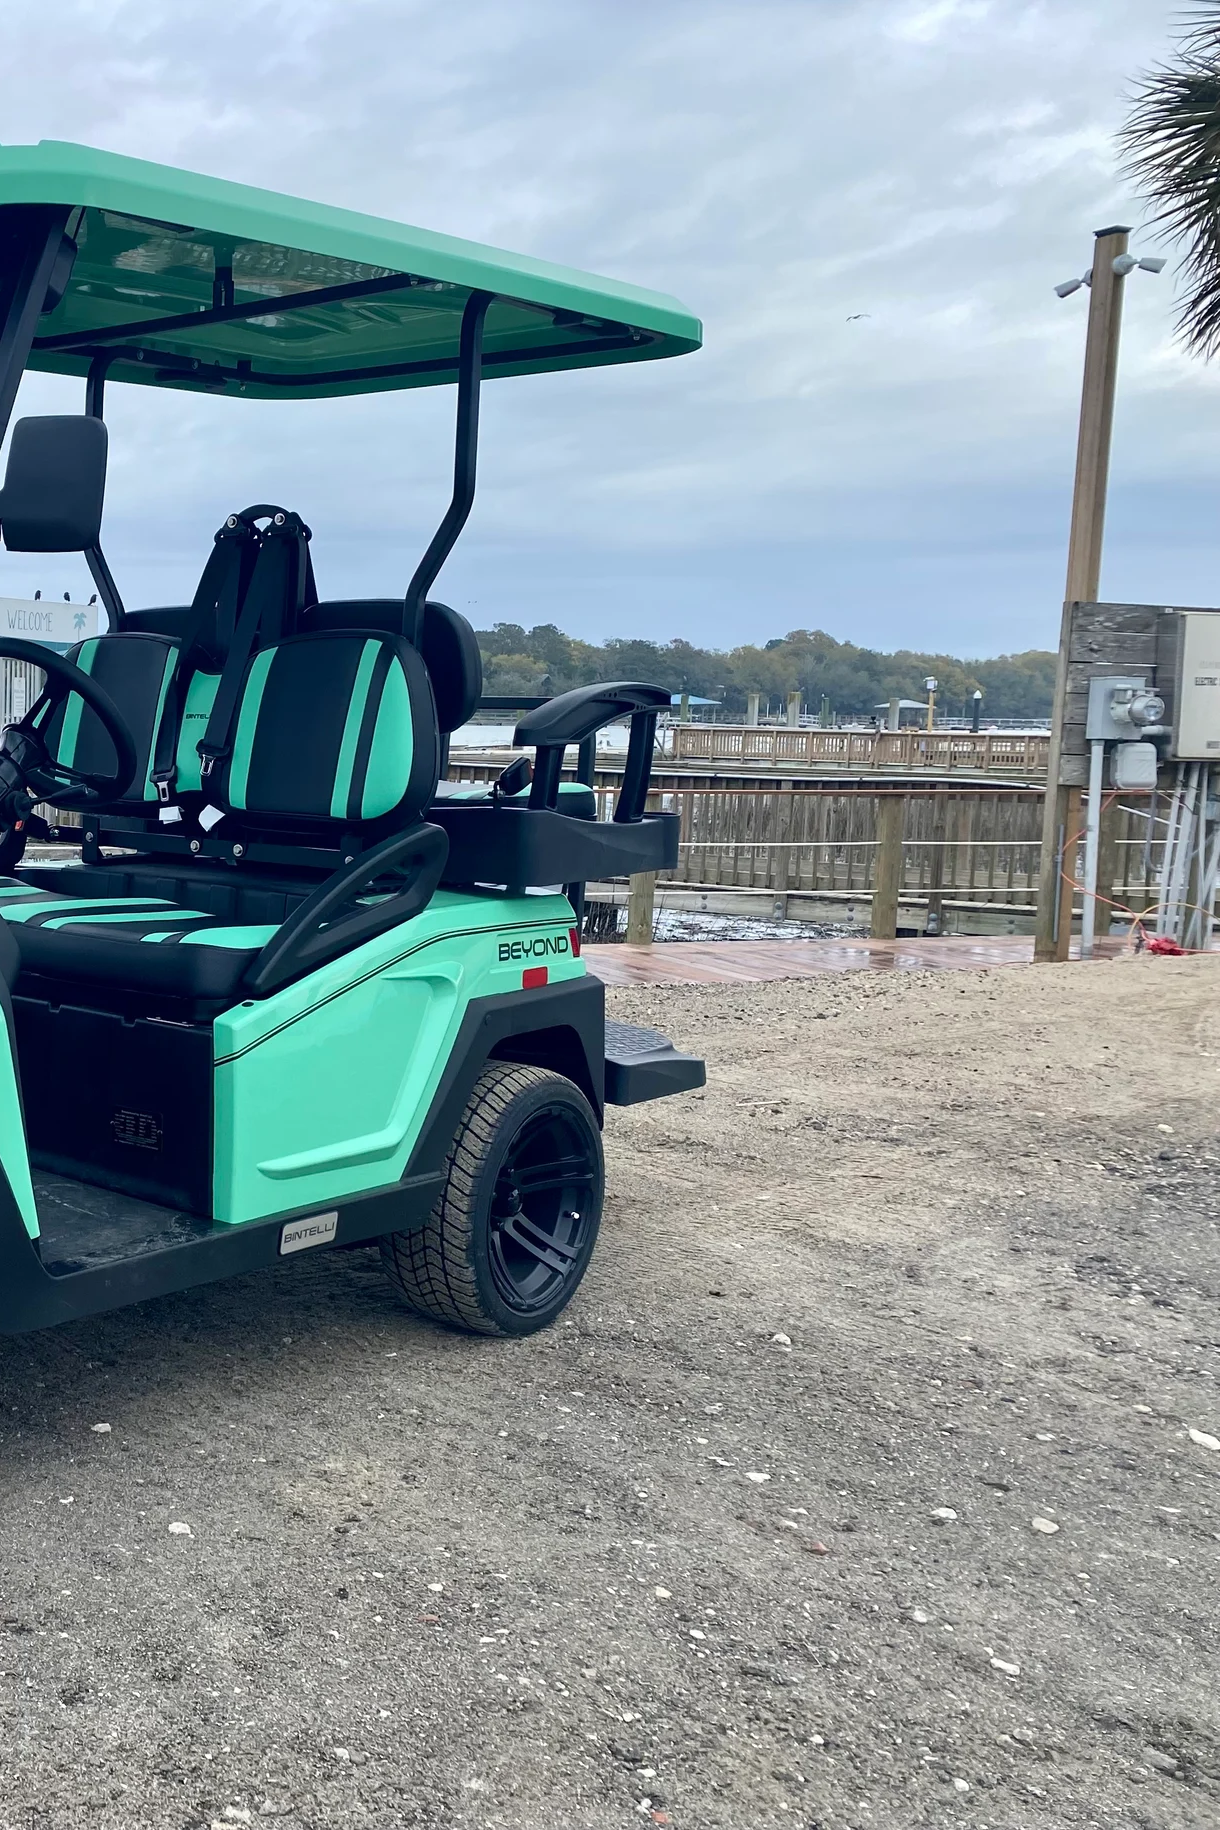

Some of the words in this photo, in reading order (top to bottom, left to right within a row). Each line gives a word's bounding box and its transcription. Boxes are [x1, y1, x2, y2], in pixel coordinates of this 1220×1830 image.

[7, 609, 53, 632] WELCOME
[498, 935, 569, 962] BEYOND
[284, 1221, 336, 1244] BINTELLI
